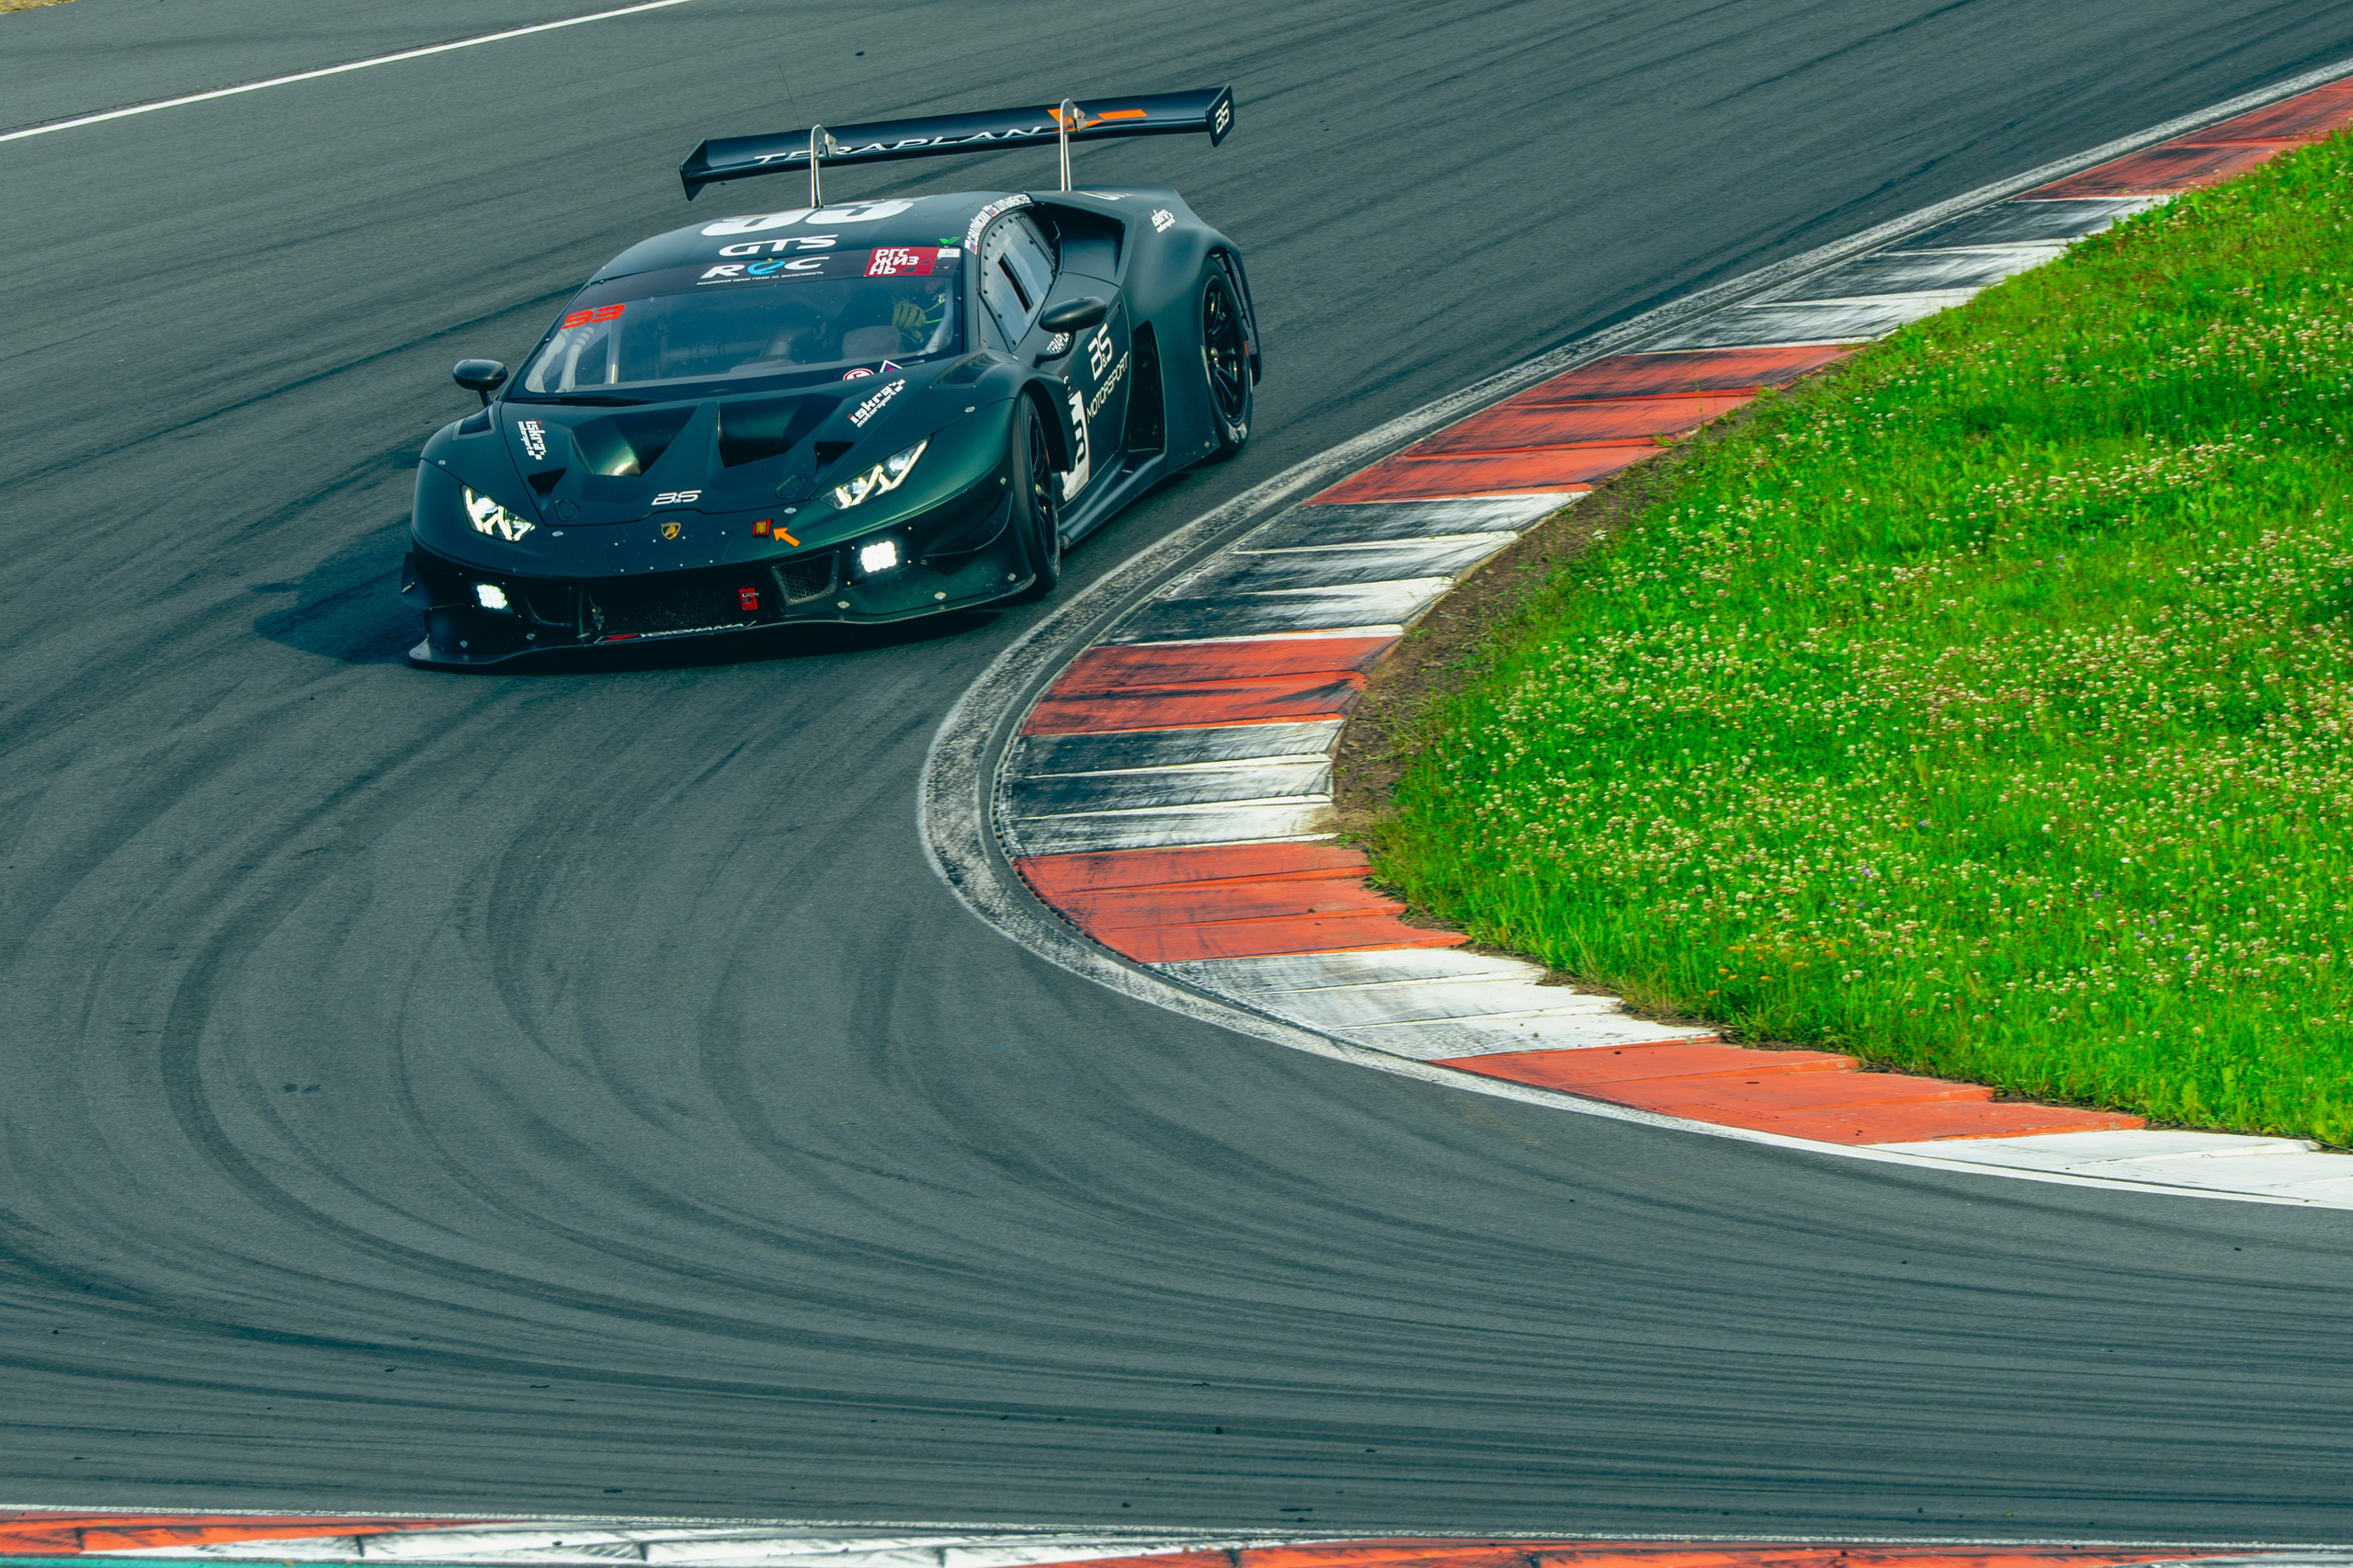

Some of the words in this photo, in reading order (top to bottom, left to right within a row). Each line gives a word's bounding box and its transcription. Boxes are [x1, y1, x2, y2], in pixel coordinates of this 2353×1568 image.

[754, 127, 1041, 165] TERAPLAN
[719, 234, 839, 256] GTS
[875, 248, 910, 258] РГС
[699, 256, 831, 279] ROC
[869, 265, 897, 276] НЬ
[872, 256, 920, 267] ЖИЗ
[561, 303, 626, 330] 93
[1046, 332, 1070, 355] TERAPLA
[1086, 350, 1129, 424] MOTORSPORT
[651, 489, 702, 506] B&S
